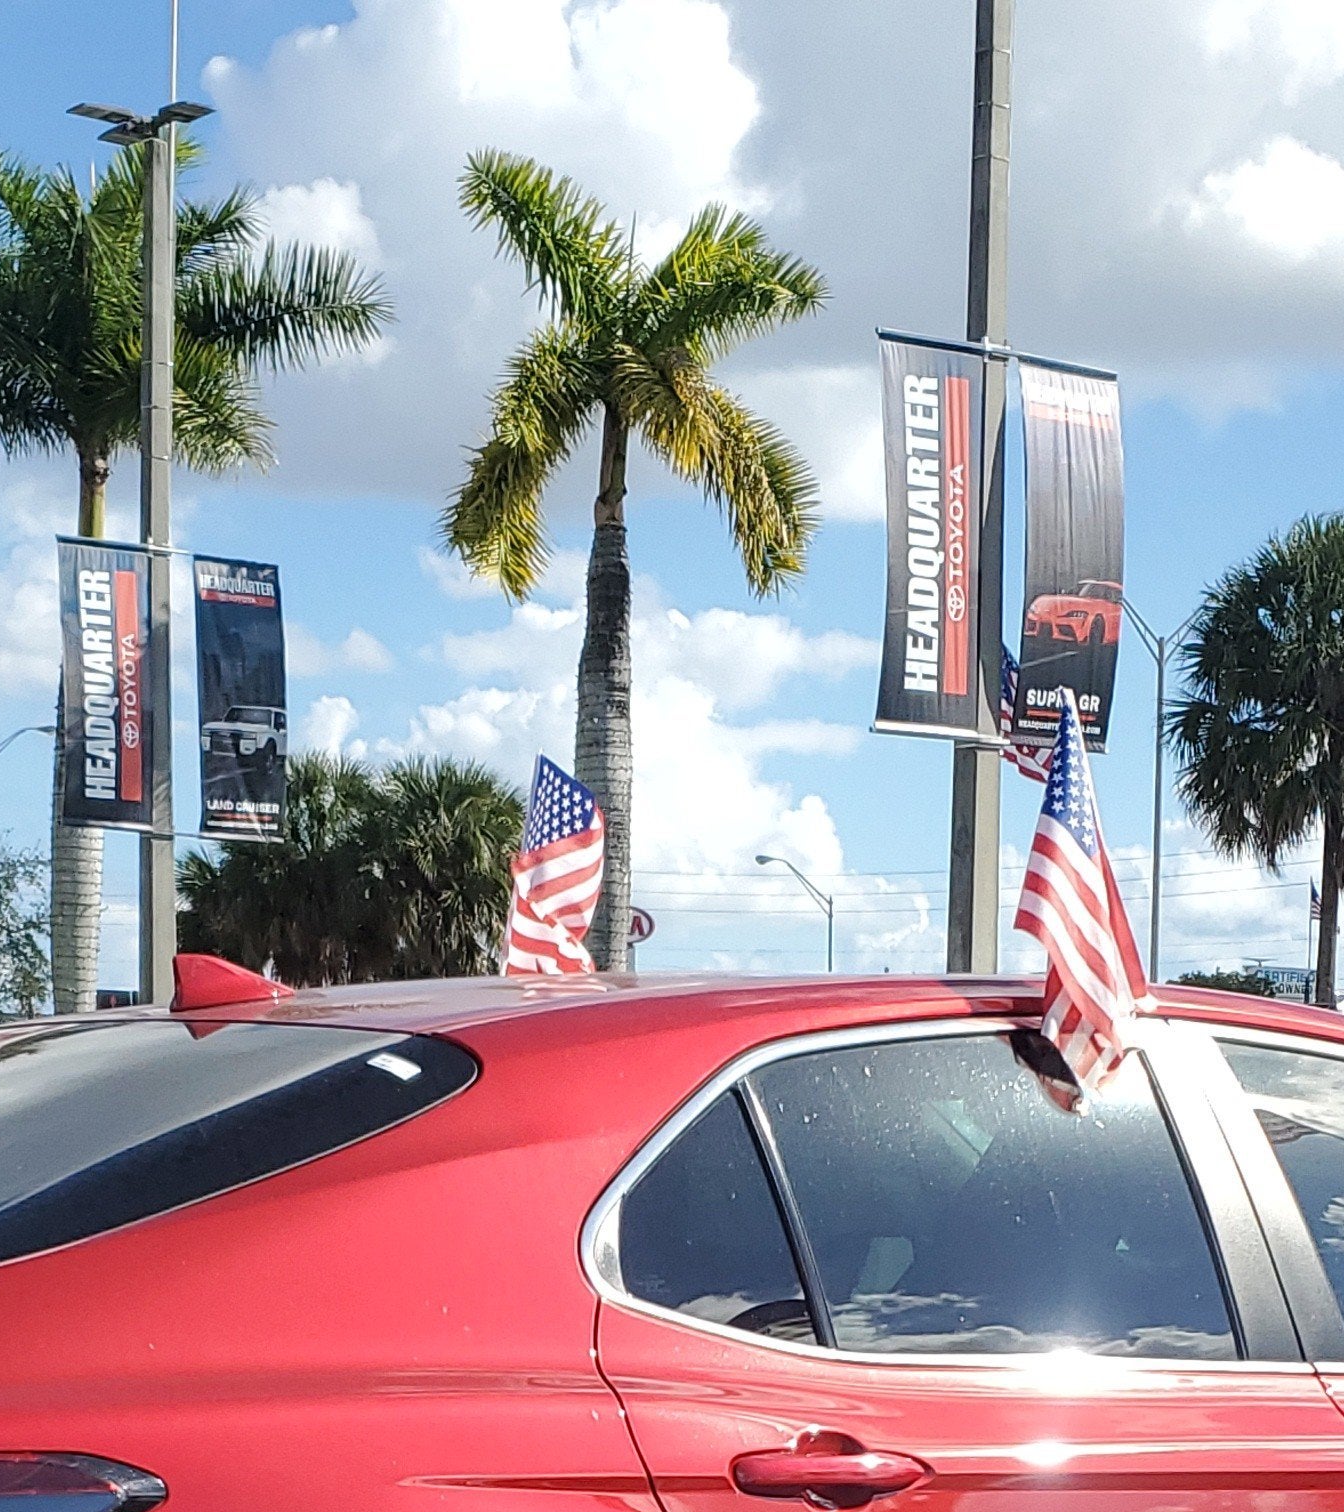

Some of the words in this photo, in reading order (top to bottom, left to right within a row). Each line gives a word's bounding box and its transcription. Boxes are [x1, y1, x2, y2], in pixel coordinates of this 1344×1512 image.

[903, 374, 944, 693] HEADQUARTER
[948, 464, 965, 582] TOYOTA
[199, 574, 275, 597] HEADQUARTER
[79, 569, 119, 800] HEADQUARTER
[121, 634, 137, 719] TOYOTA
[1079, 693, 1101, 712] GR
[207, 800, 234, 811] LAND
